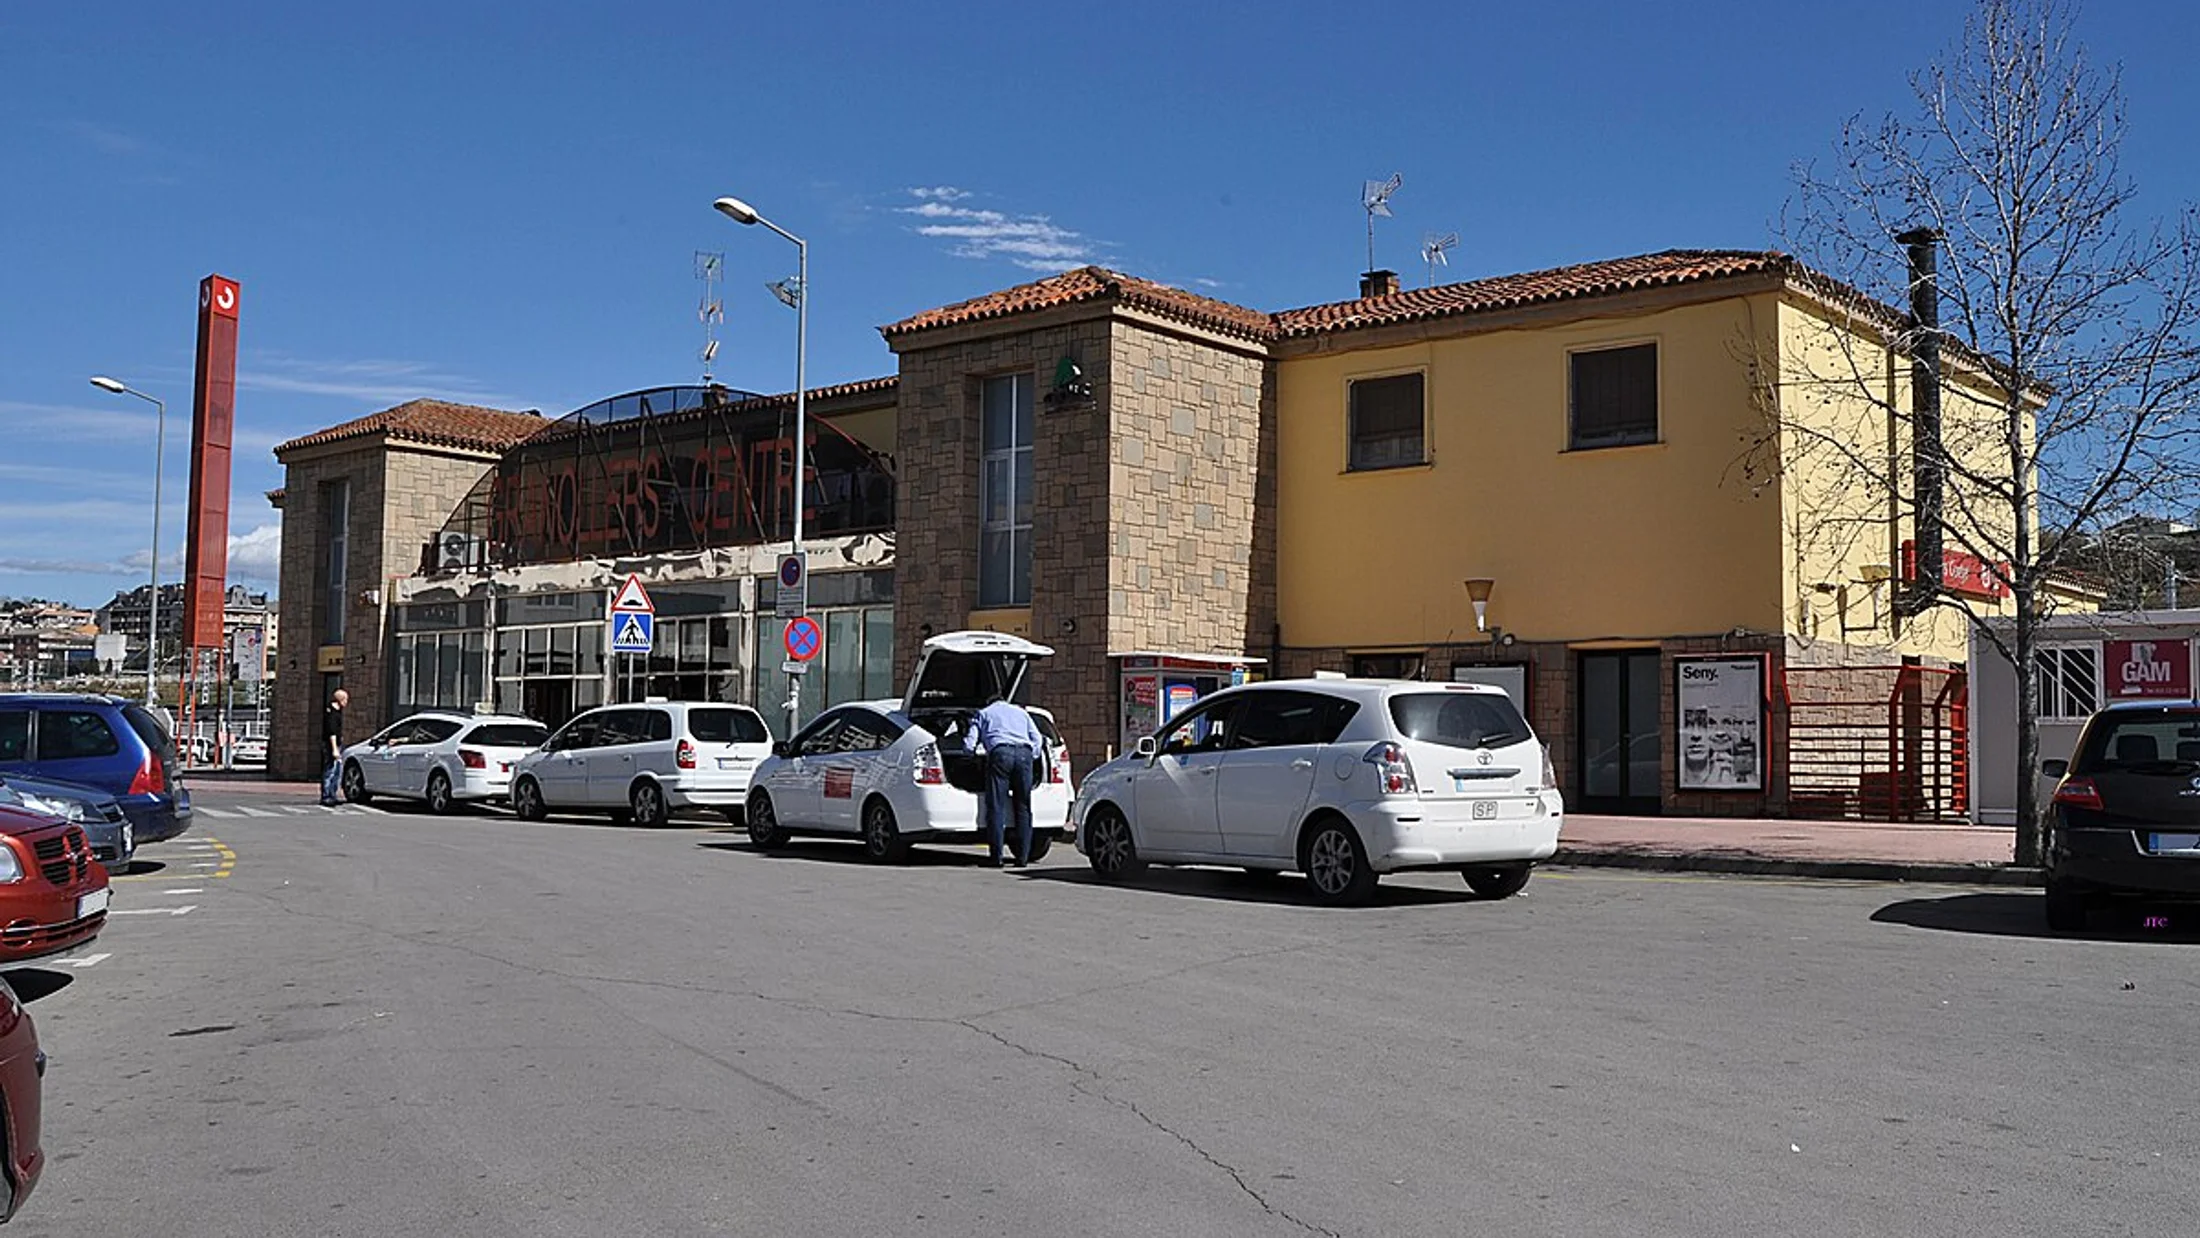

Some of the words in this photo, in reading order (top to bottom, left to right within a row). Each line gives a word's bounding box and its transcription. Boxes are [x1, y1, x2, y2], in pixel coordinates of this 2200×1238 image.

[491, 451, 661, 545] GRANOLLERS
[689, 432, 817, 534] CENTRE
[1683, 665, 1719, 681] Seny.
[2121, 661, 2171, 682] GAM
